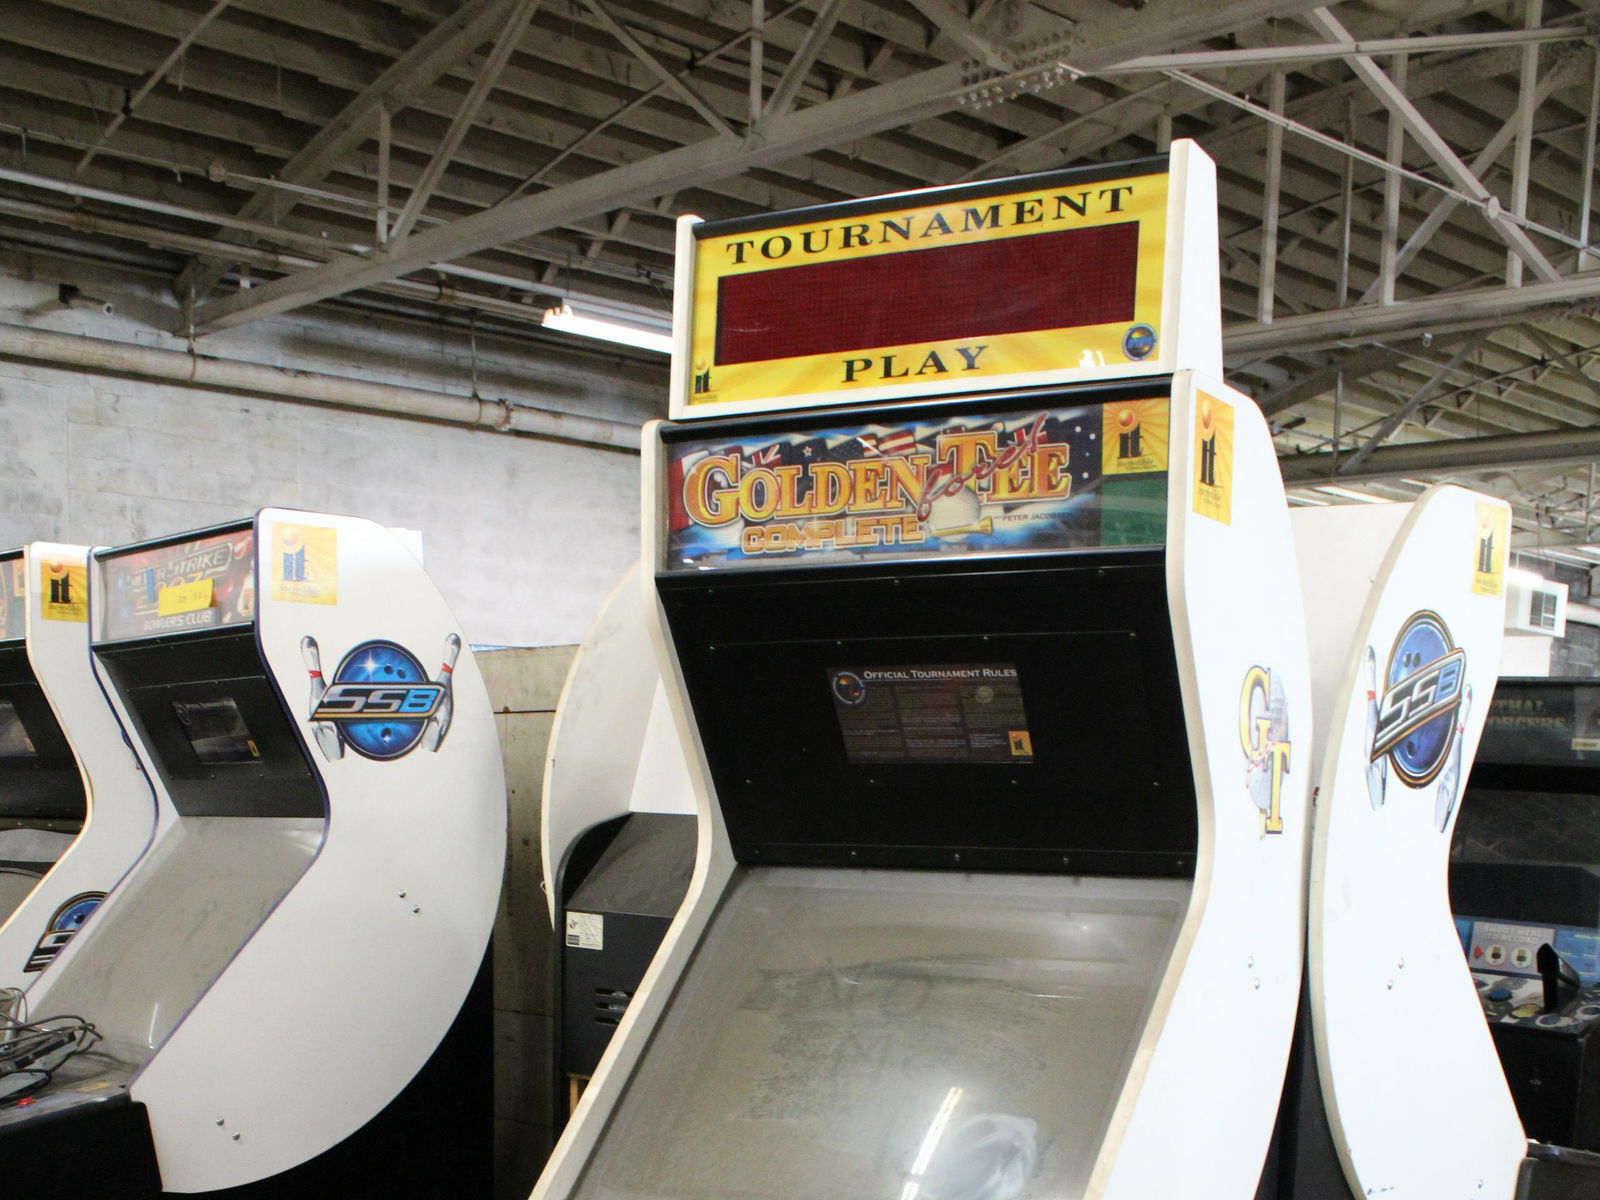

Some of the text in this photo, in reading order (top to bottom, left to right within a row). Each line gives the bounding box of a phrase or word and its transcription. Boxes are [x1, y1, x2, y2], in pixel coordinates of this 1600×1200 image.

[726, 186, 1134, 265] TOURNAMENT
[841, 344, 989, 383] PLAY
[684, 430, 1072, 528] GOLDEN TEE
[742, 513, 926, 555] COMPLETE
[863, 667, 1018, 680] OFFICIAL TOURNAMENT RULES
